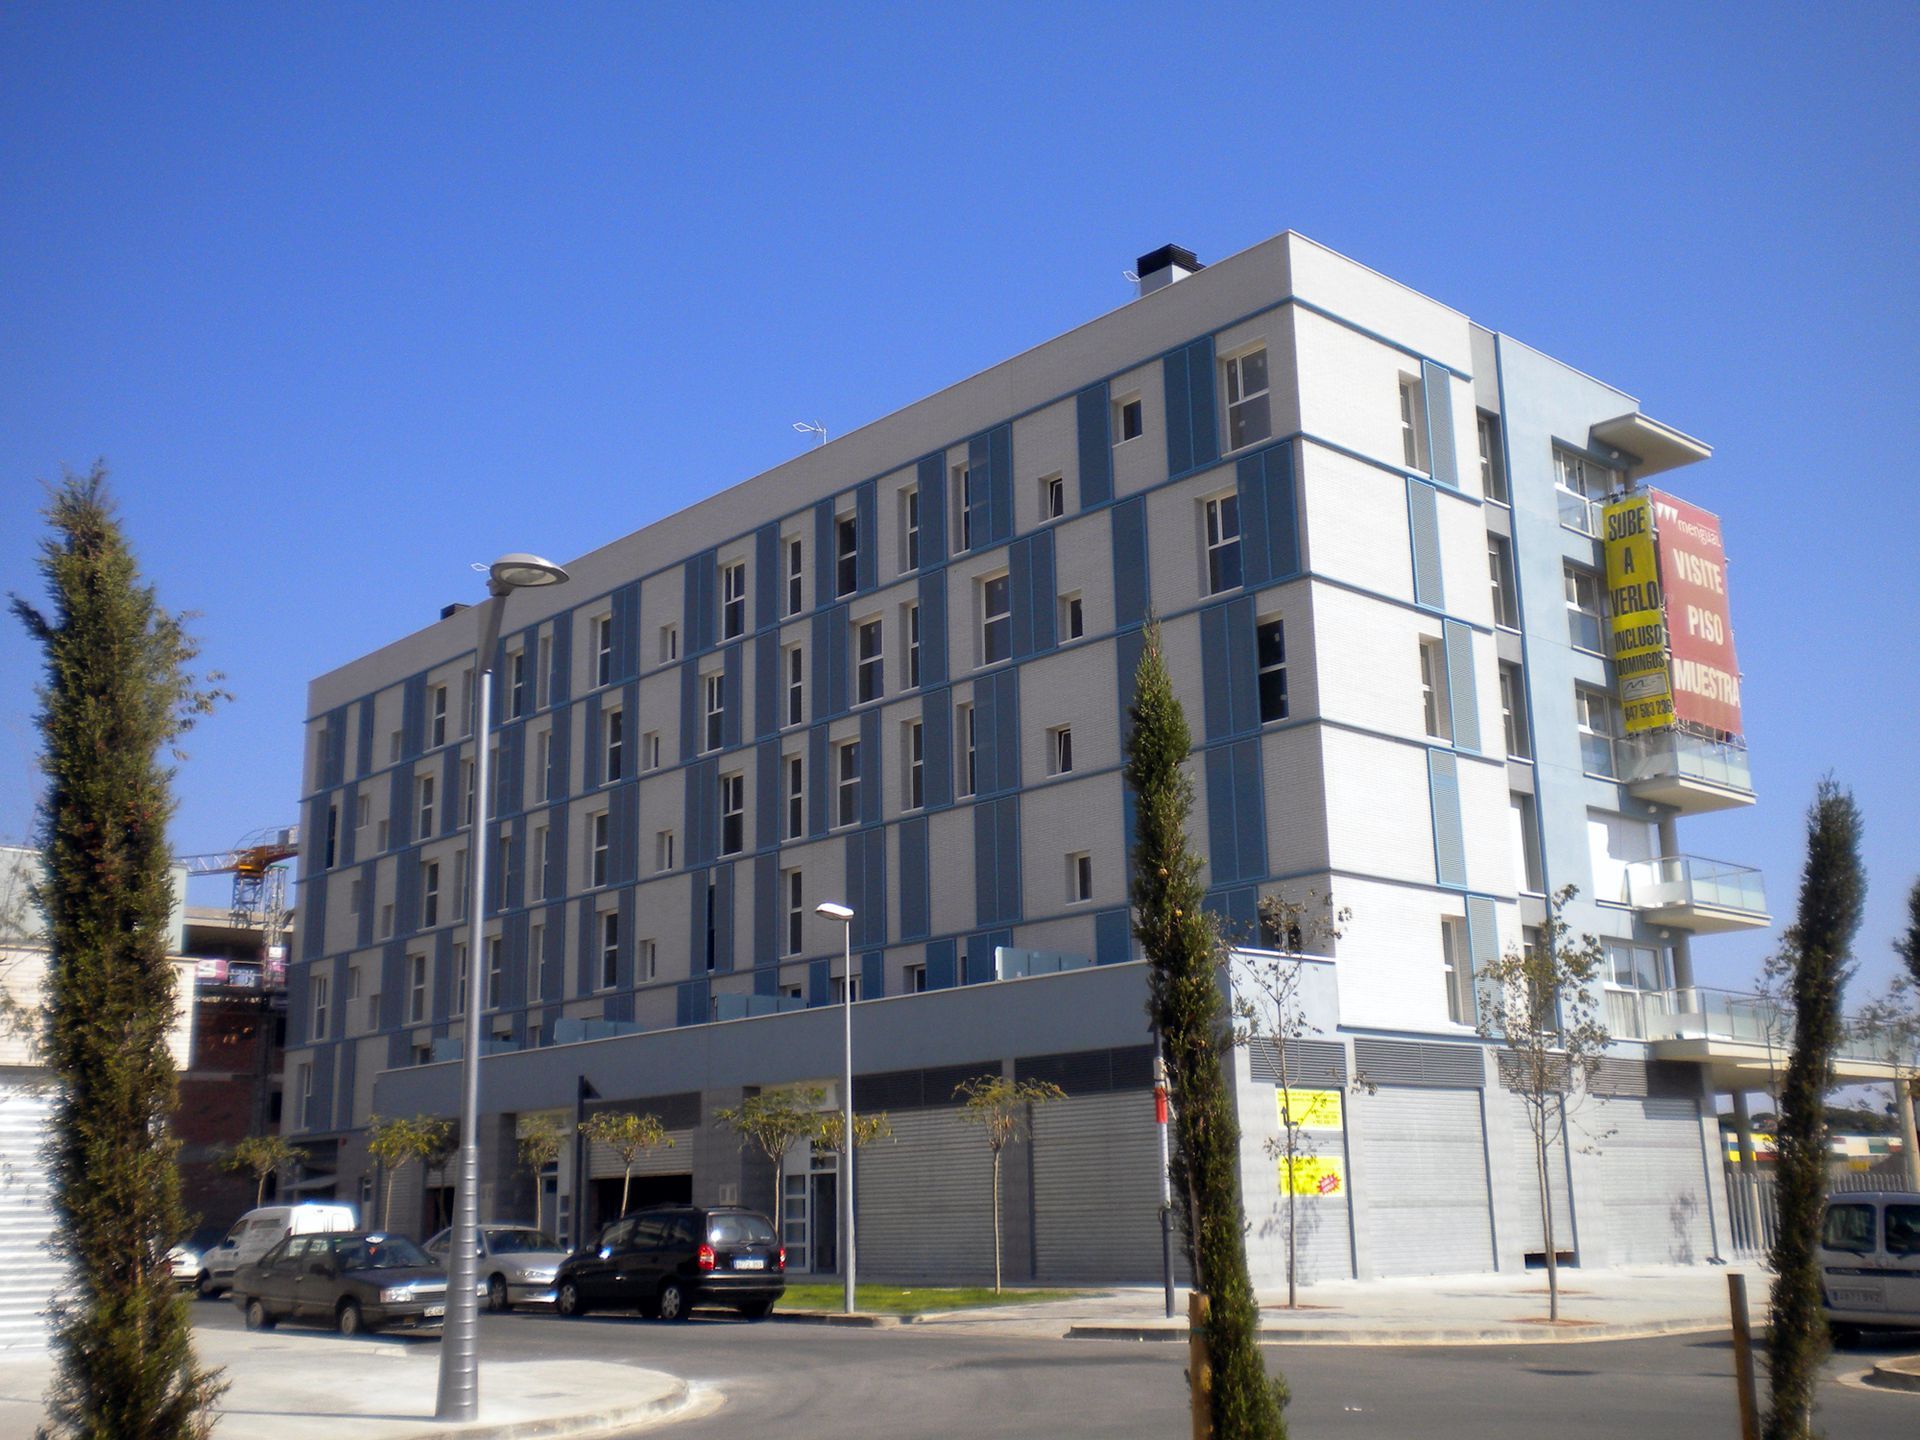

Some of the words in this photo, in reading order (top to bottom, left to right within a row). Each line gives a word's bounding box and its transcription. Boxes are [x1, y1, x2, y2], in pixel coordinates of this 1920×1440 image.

[1608, 506, 1645, 542] SUBE
[1624, 547, 1634, 575] A
[1673, 548, 1724, 595] VISITE
[1610, 580, 1659, 618] VERLO
[1615, 623, 1663, 653] INCLUSO
[1688, 604, 1724, 646] PISO
[1674, 657, 1740, 708] MUESTRA
